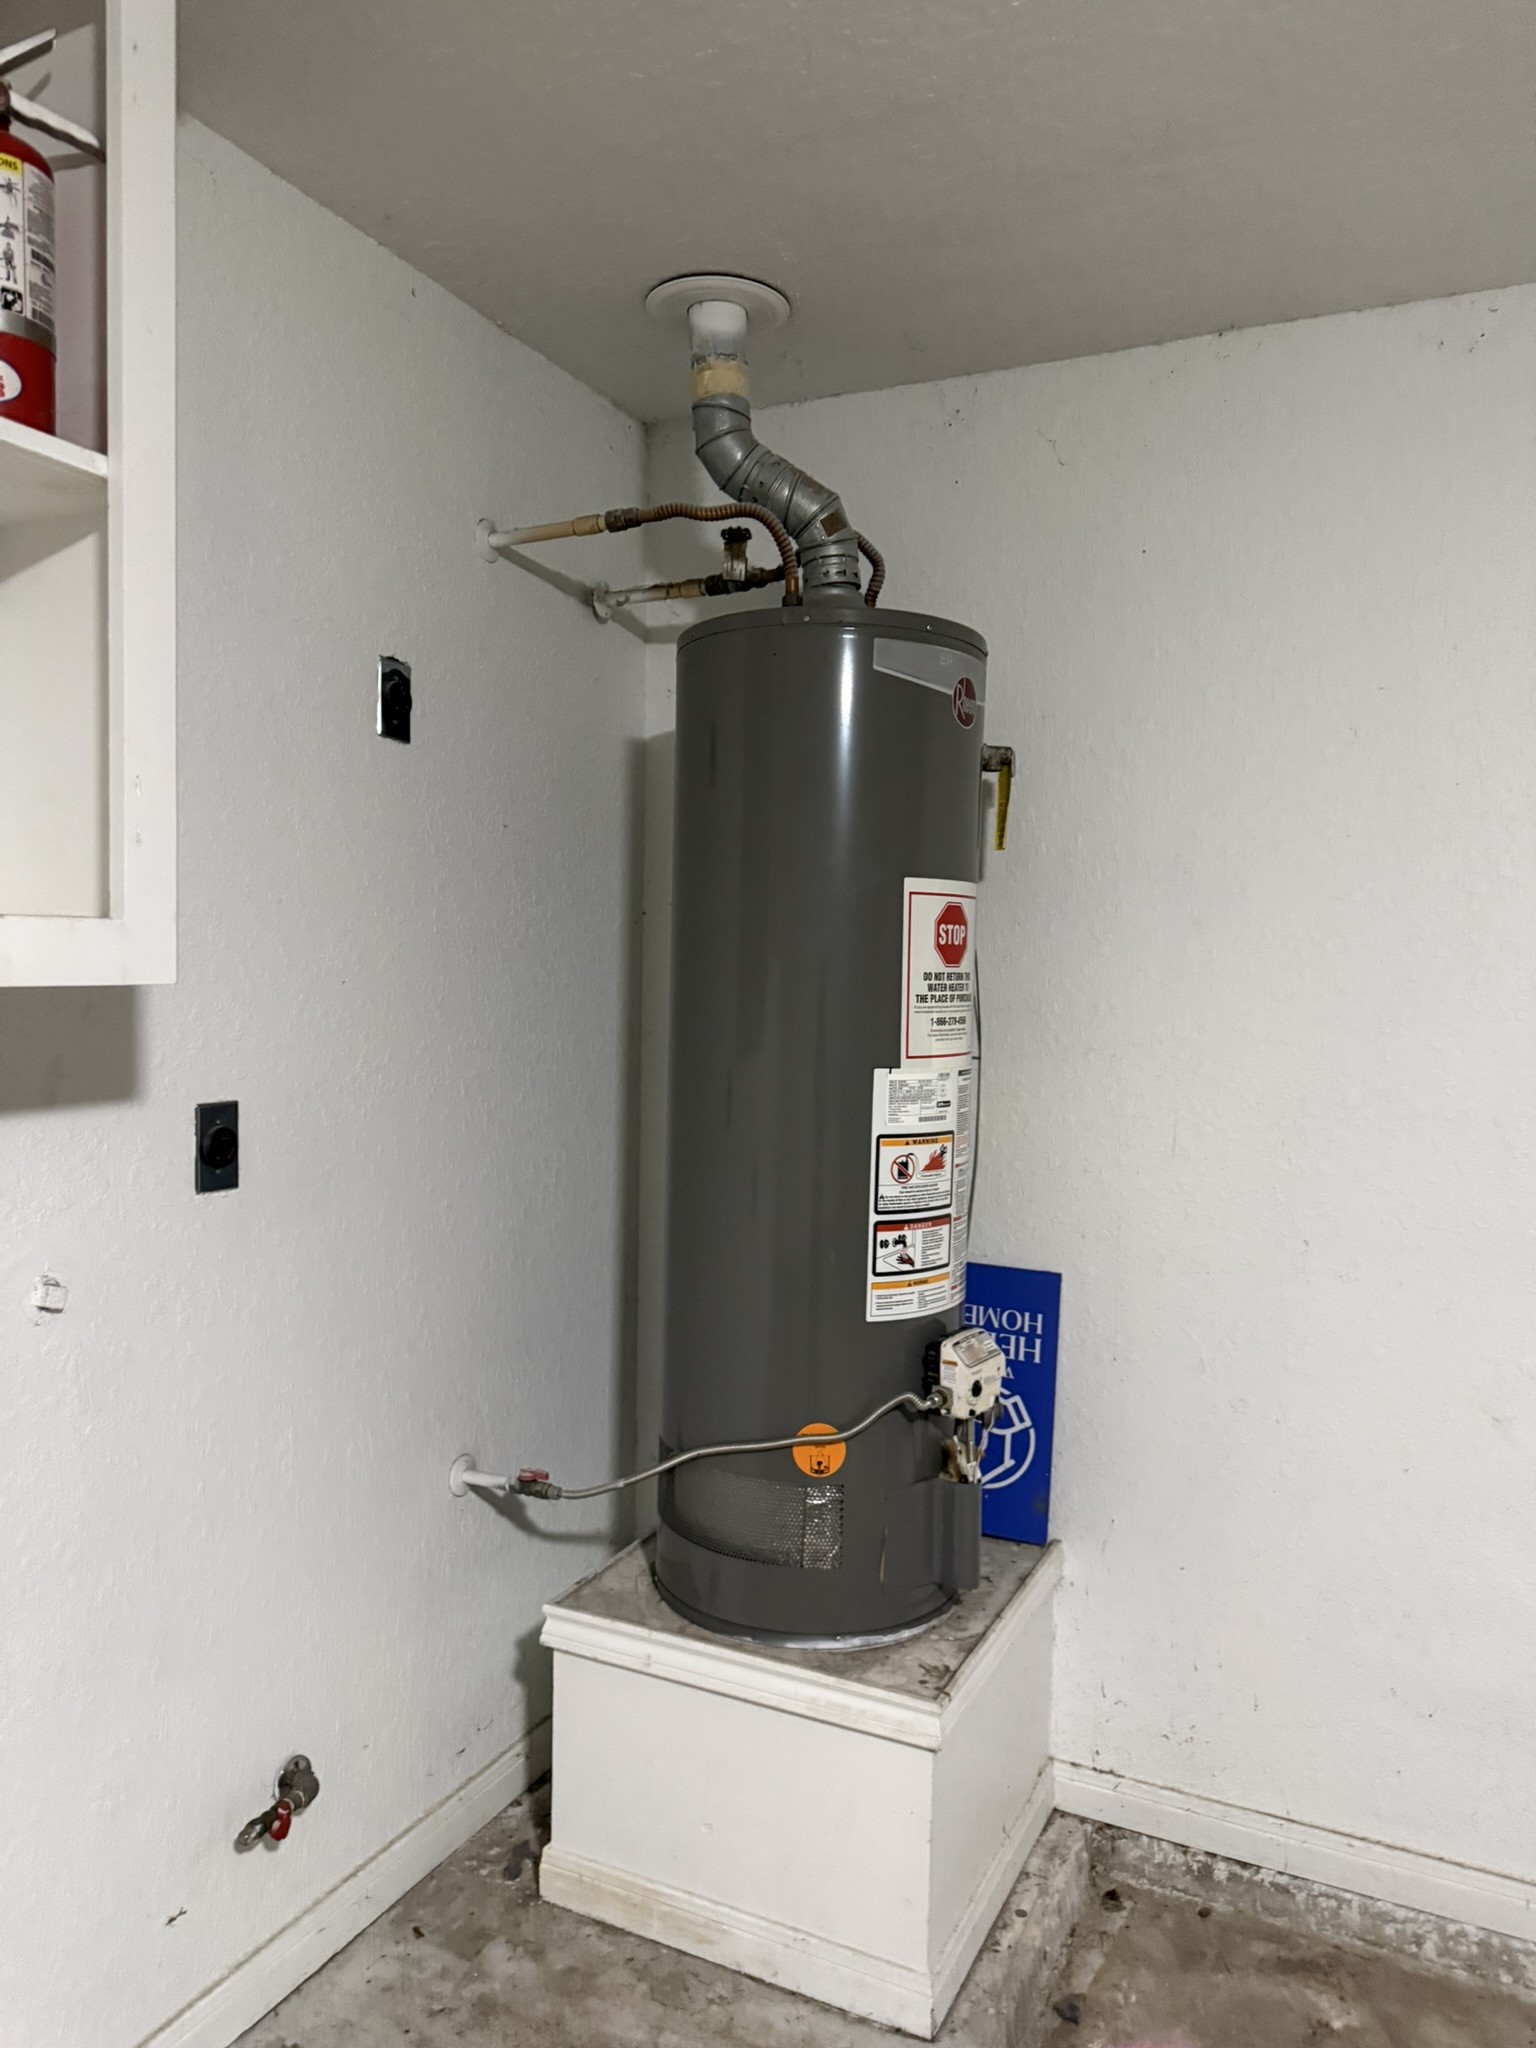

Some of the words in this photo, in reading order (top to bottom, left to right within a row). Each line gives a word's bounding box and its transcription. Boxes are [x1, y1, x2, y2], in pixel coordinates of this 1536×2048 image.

[938, 923, 966, 946] STOP
[923, 971, 933, 981] DO
[934, 971, 945, 981] NOT
[927, 982, 947, 992] WATER
[948, 982, 964, 992] HEATER
[915, 993, 929, 1004] THE
[930, 993, 948, 1003] PLACE
[949, 993, 955, 1003] OF
[912, 1137, 938, 1145] WARNING
[964, 1303, 1043, 1335] HOME
[989, 1330, 1042, 1364] HE
